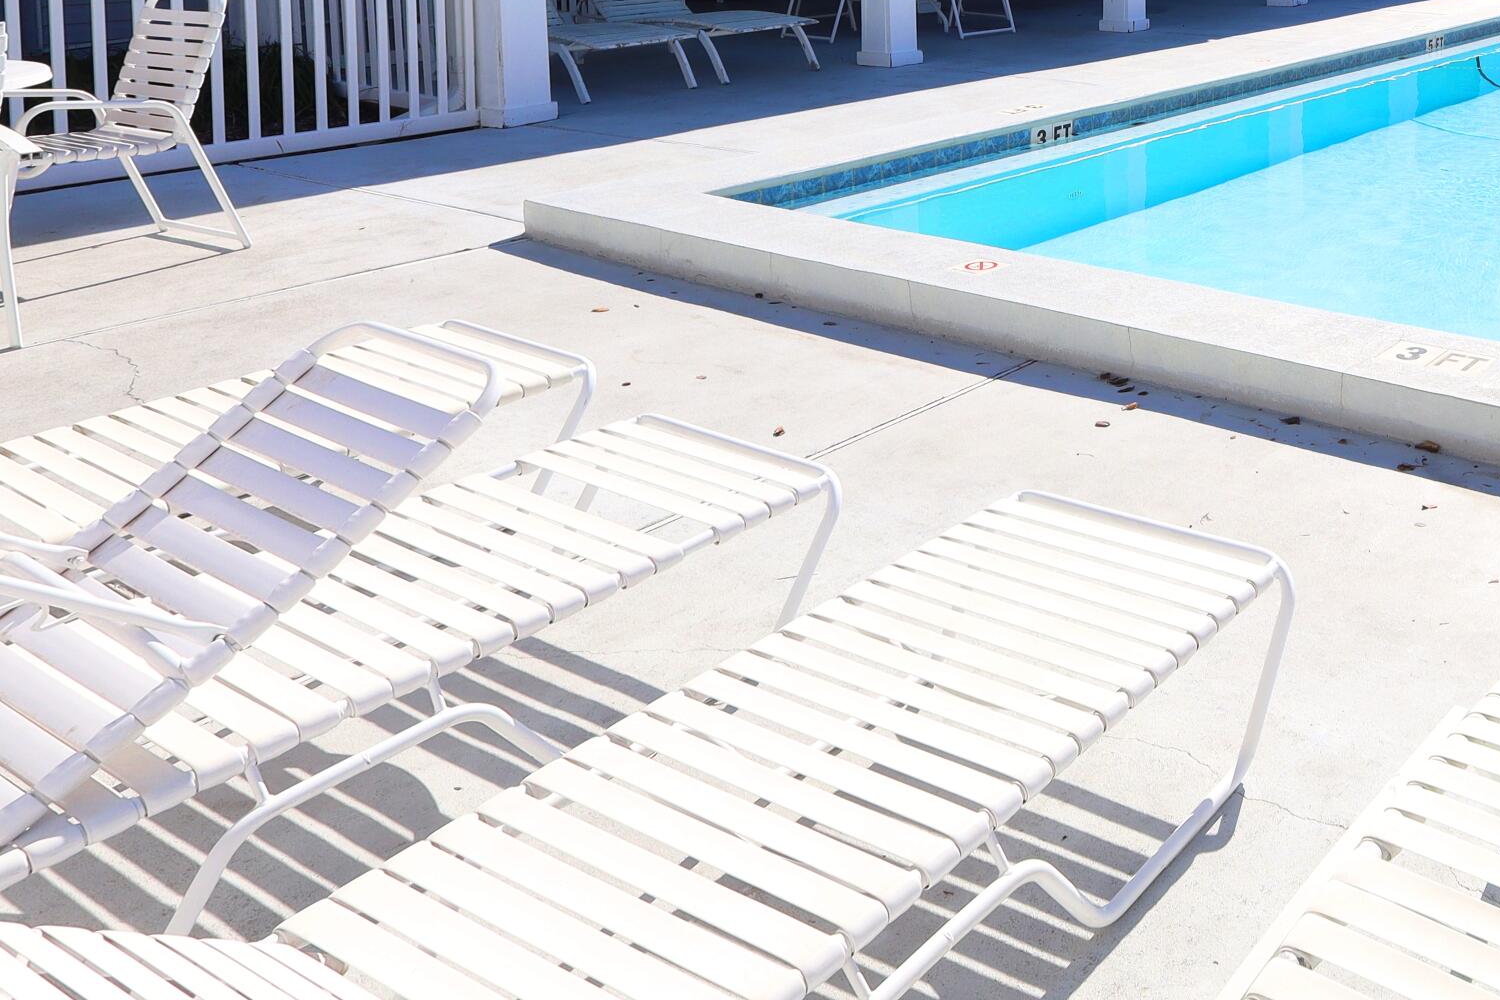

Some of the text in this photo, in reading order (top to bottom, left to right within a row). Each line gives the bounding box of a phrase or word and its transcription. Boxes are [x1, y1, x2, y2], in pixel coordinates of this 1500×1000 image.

[1435, 36, 1443, 49] FT
[1037, 122, 1072, 144] 3 FT
[1396, 346, 1491, 372] 3 FT
